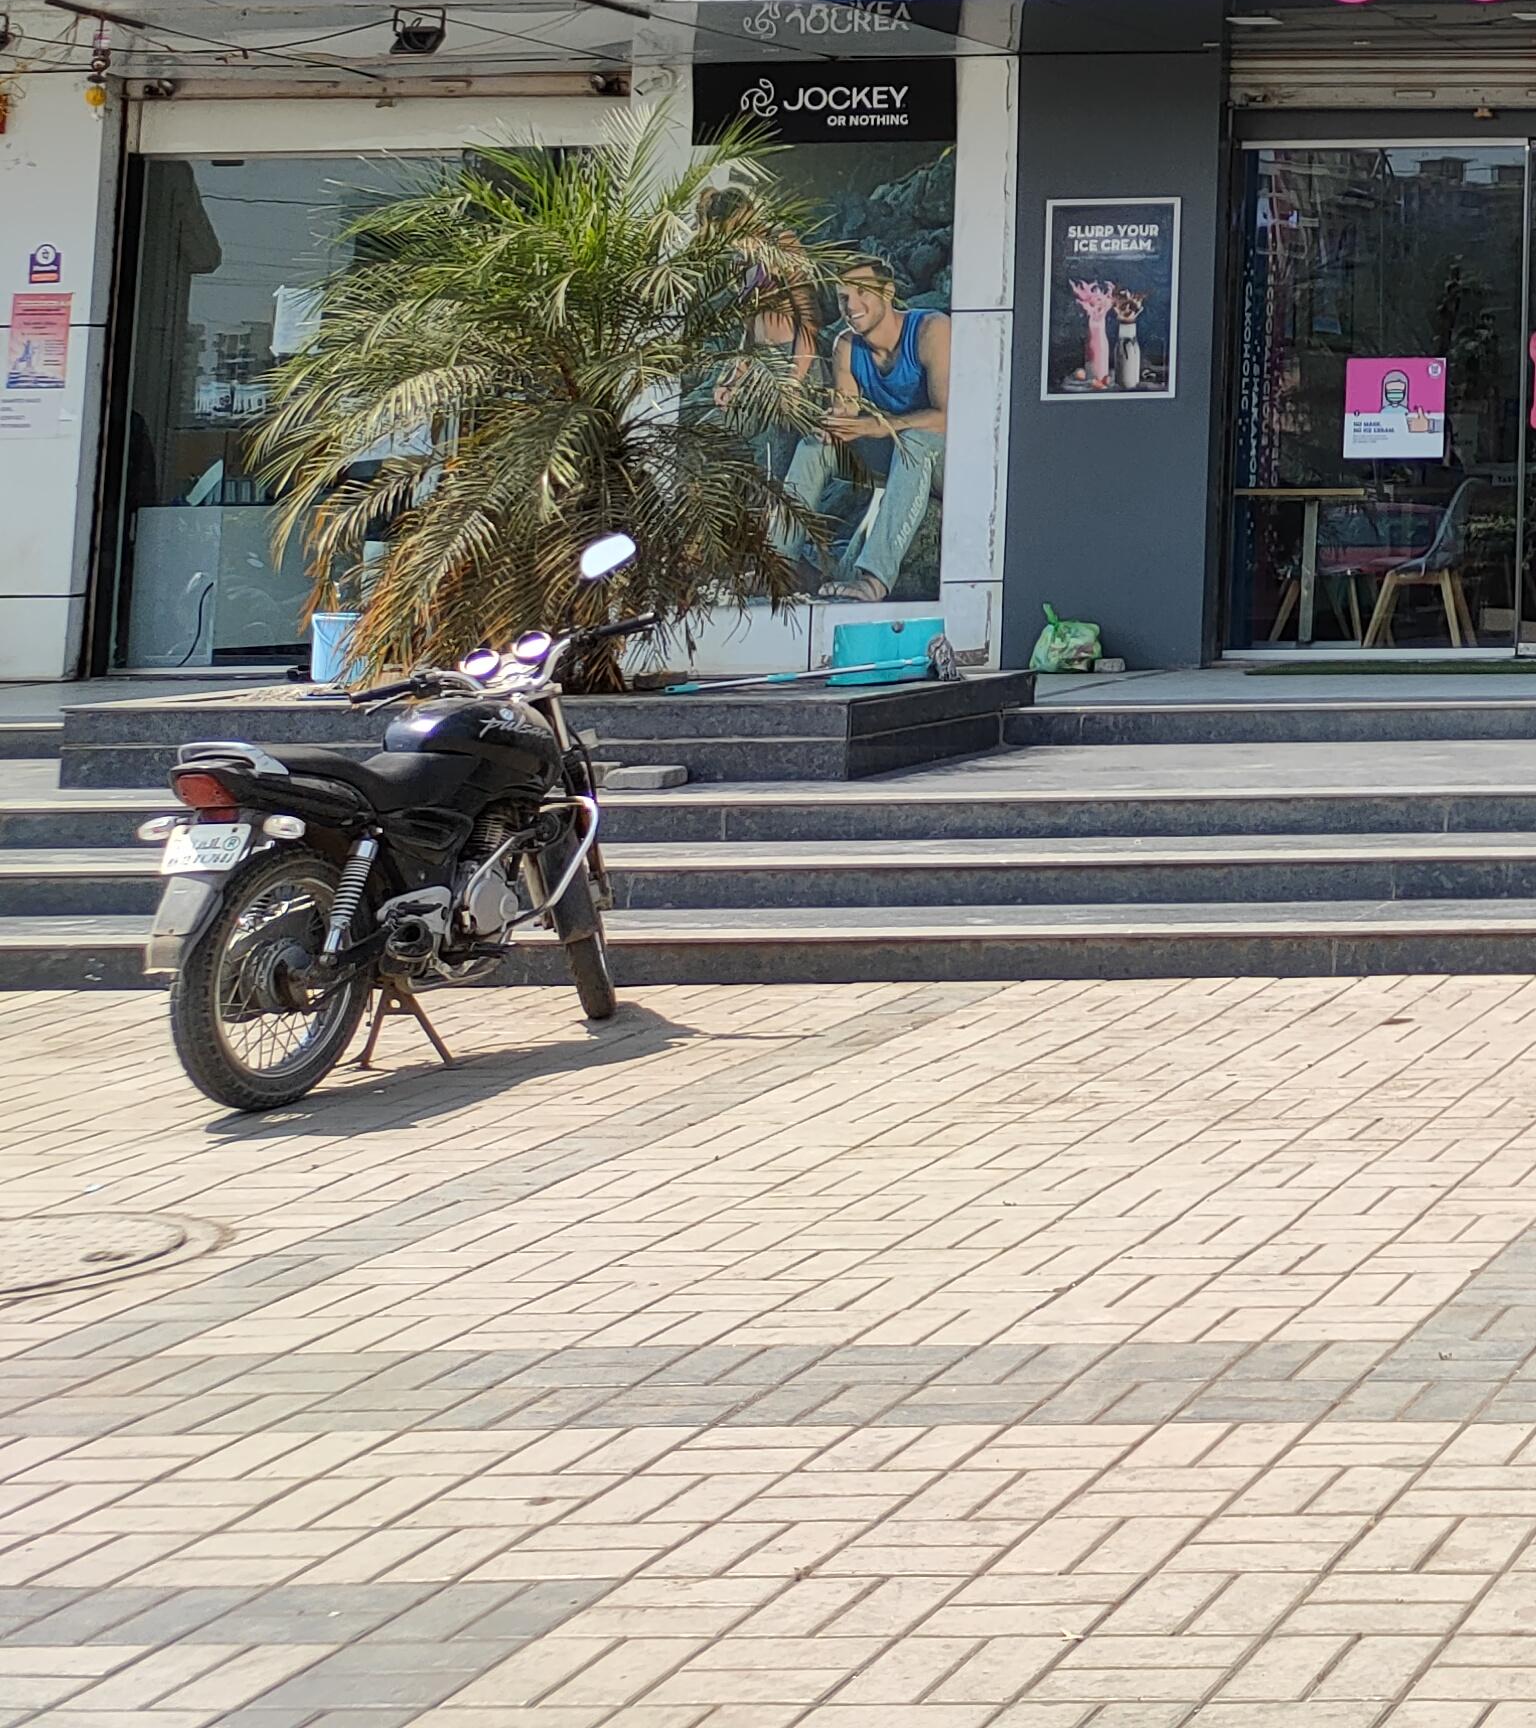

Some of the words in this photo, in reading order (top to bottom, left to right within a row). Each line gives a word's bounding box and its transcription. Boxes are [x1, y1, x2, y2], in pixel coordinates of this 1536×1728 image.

[782, 85, 907, 112] JOCKEY
[827, 115, 846, 127] OR
[850, 114, 909, 126] NOTHING
[1068, 225, 1115, 238] SLURP
[1118, 224, 1159, 237] YOUR
